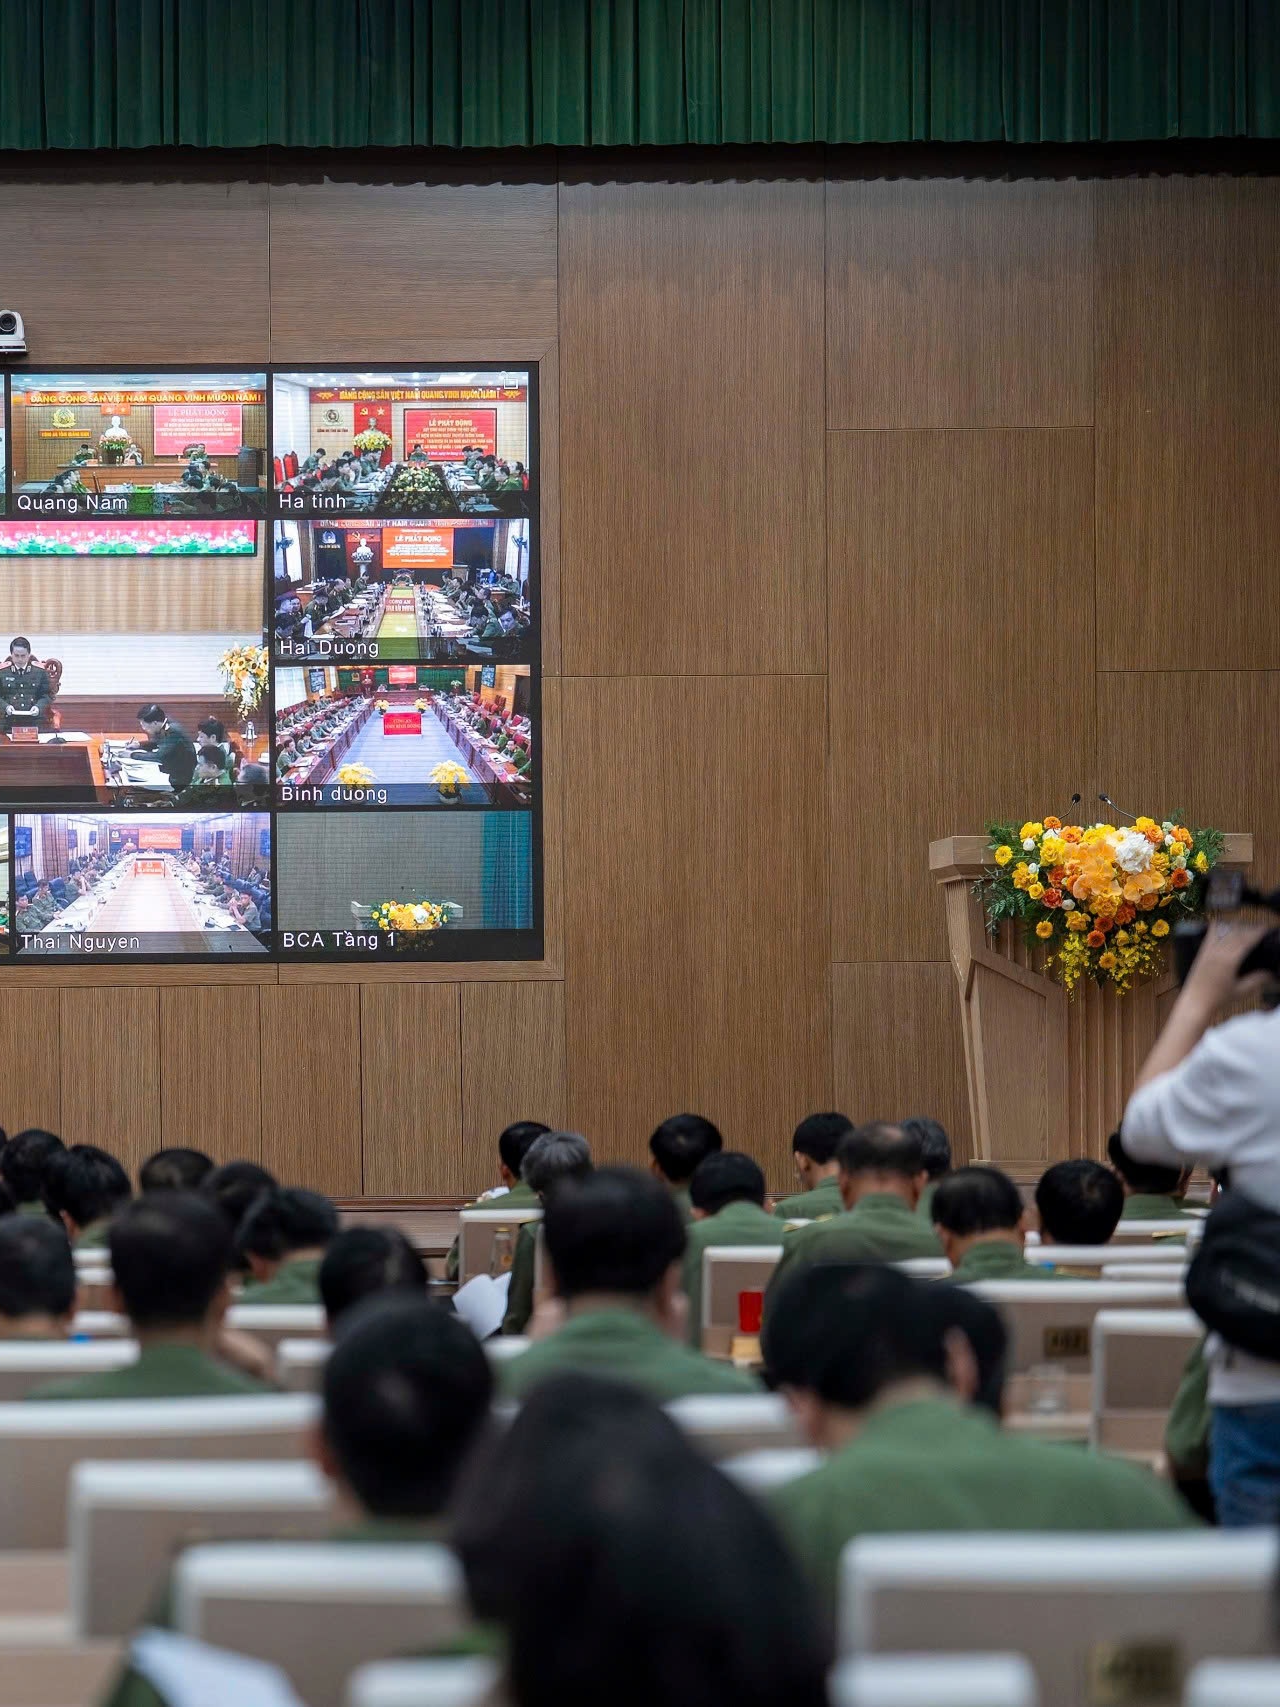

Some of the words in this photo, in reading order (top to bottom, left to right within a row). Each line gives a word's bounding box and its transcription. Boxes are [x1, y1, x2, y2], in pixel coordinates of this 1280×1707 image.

[30, 393, 57, 403] ĐẢNG
[59, 393, 87, 404] CỘNG
[89, 392, 107, 403] SẢN
[107, 393, 125, 404] VIỆT
[206, 393, 235, 402] MUÔN
[236, 393, 257, 402] NĂM
[18, 495, 78, 513] Quang
[86, 495, 128, 510] Nam
[280, 494, 304, 509] Ha
[311, 494, 347, 509] tinh
[280, 640, 311, 655] Hai
[320, 640, 379, 657] Duong
[282, 786, 323, 801] Binh
[330, 786, 387, 804] duong
[21, 934, 60, 949] Thai
[69, 934, 140, 952] Nguyen
[283, 932, 325, 948] BCA
[332, 930, 378, 950] Tầng
[387, 931, 395, 947] 1
